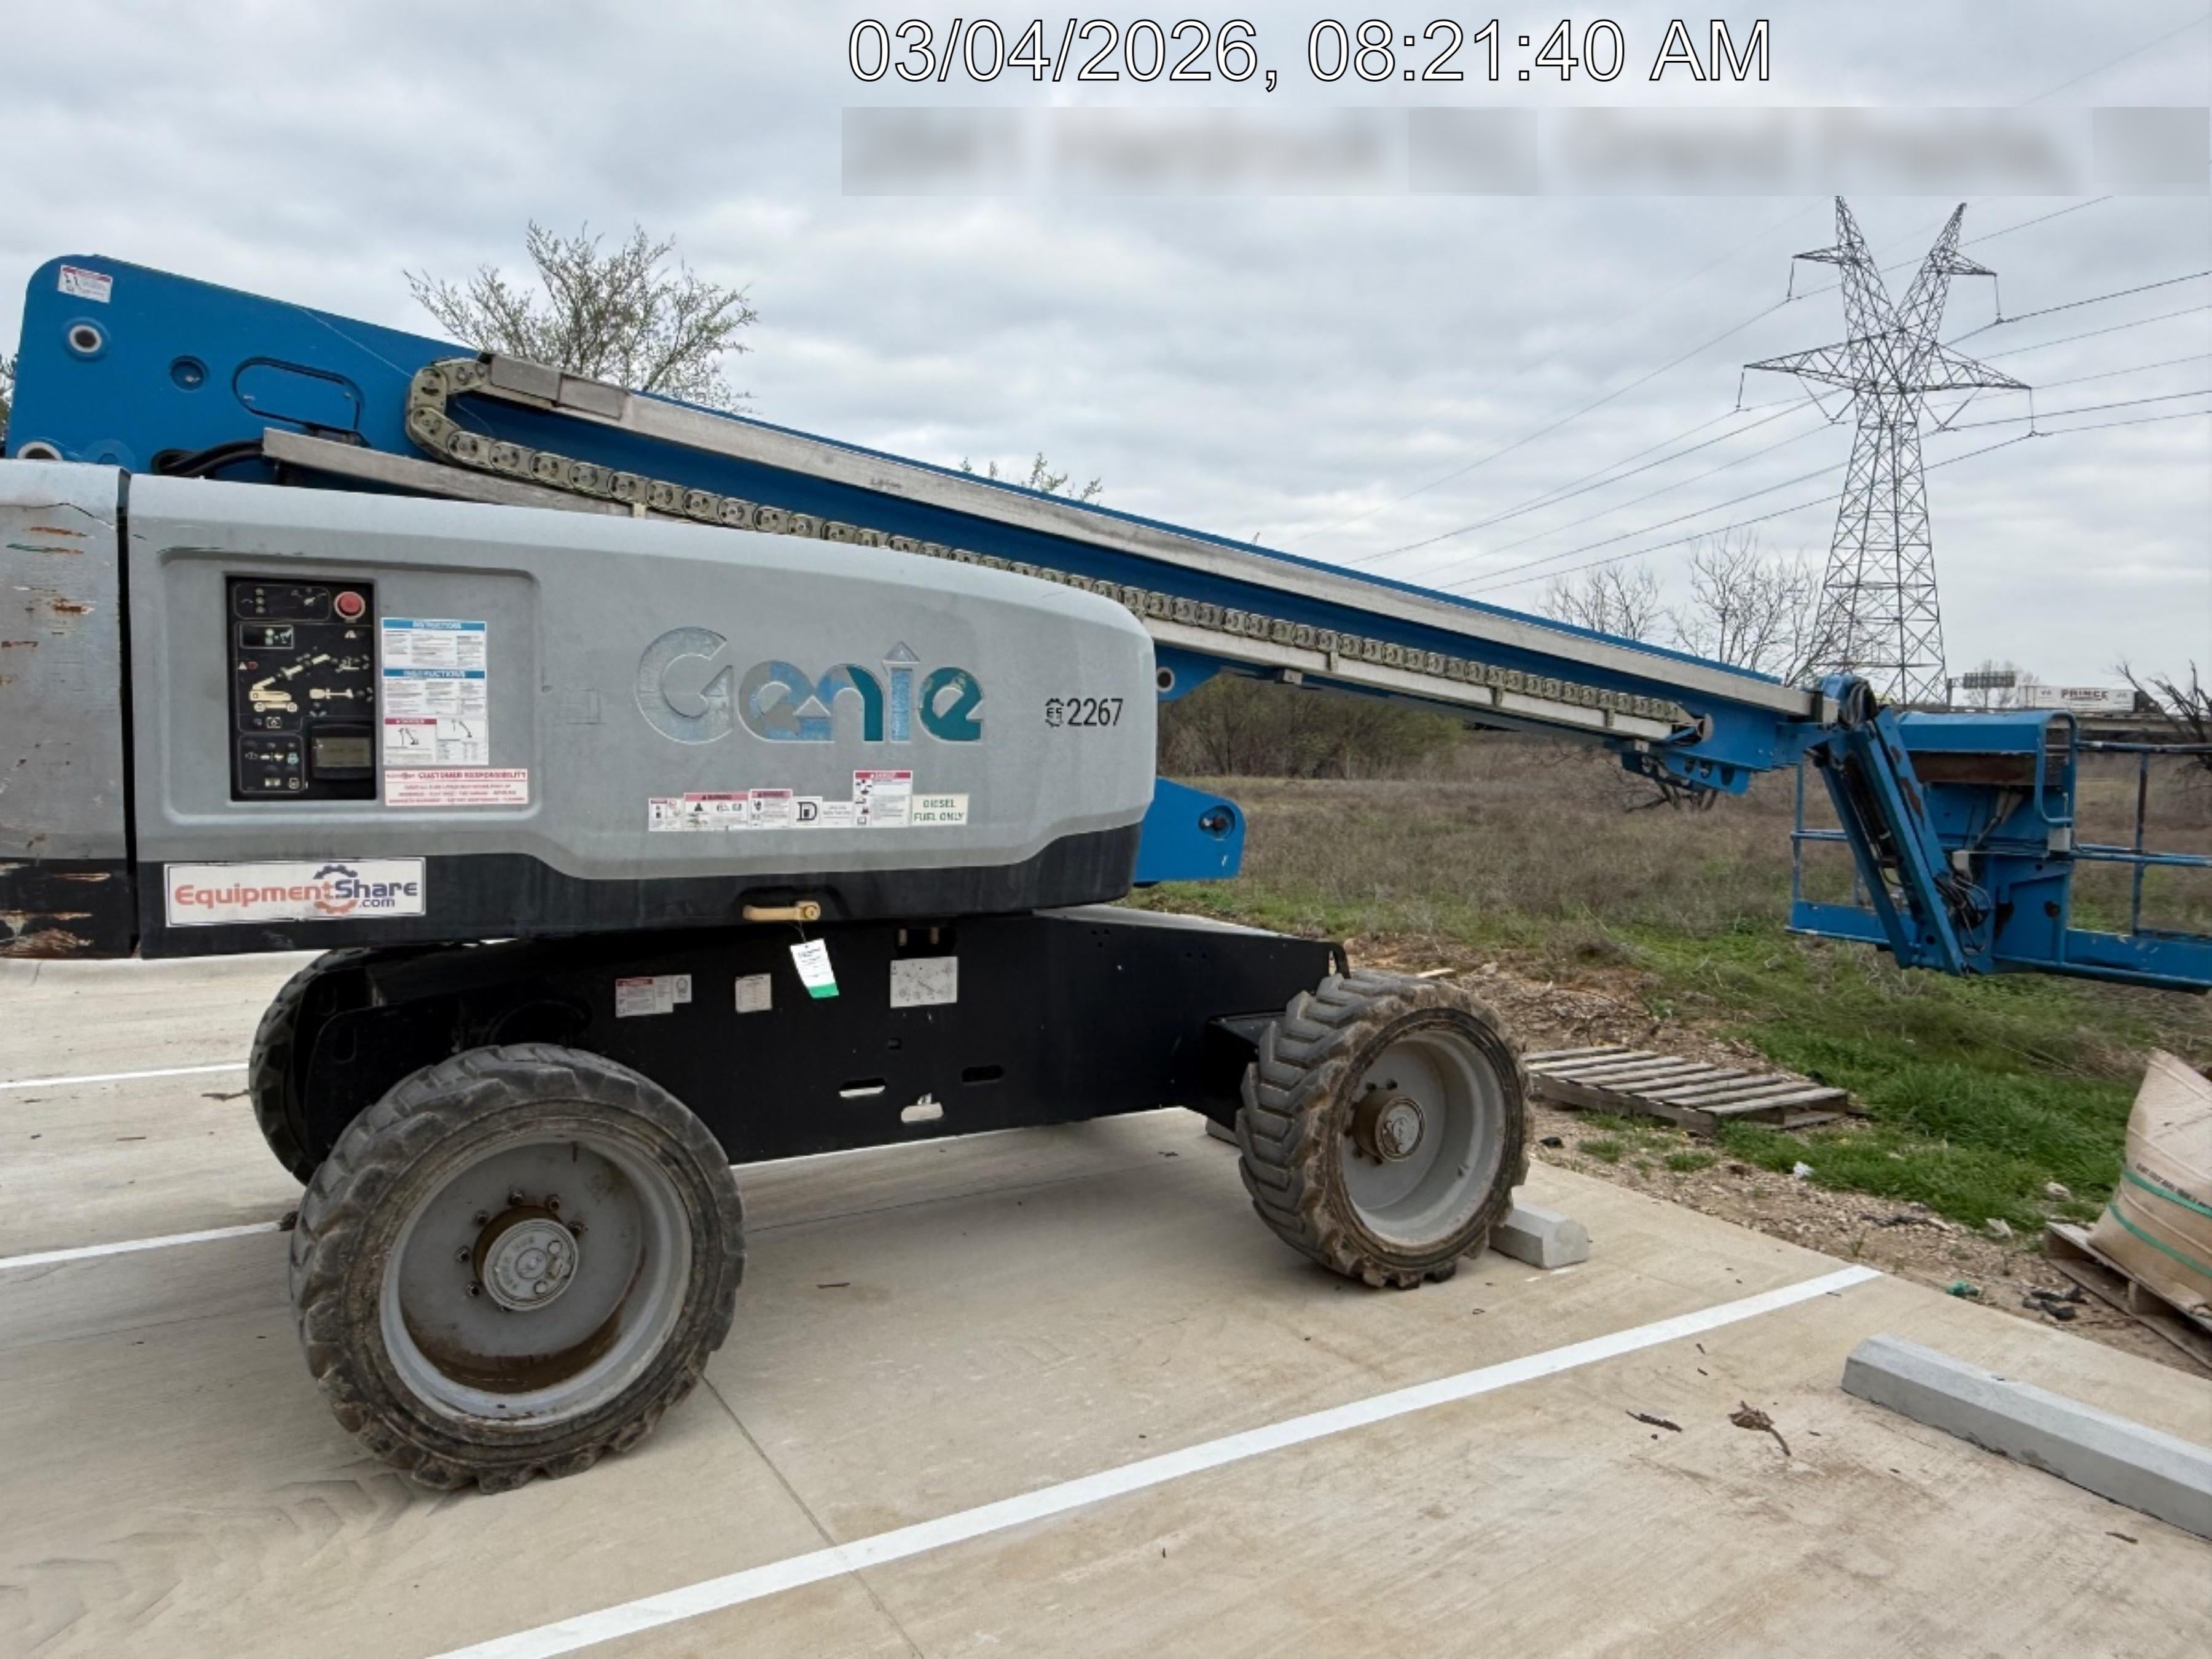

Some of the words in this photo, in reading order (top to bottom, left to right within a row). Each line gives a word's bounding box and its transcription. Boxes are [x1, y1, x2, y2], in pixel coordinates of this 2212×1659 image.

[635, 626, 984, 745] Genie
[2061, 688, 2109, 701] PRINCE
[1066, 697, 1124, 727] 2267
[923, 799, 957, 808] DIESEL
[913, 812, 936, 822] FUEL
[939, 811, 965, 822] ONLY
[175, 879, 418, 909] EquipmentShare
[359, 898, 395, 908] .com
